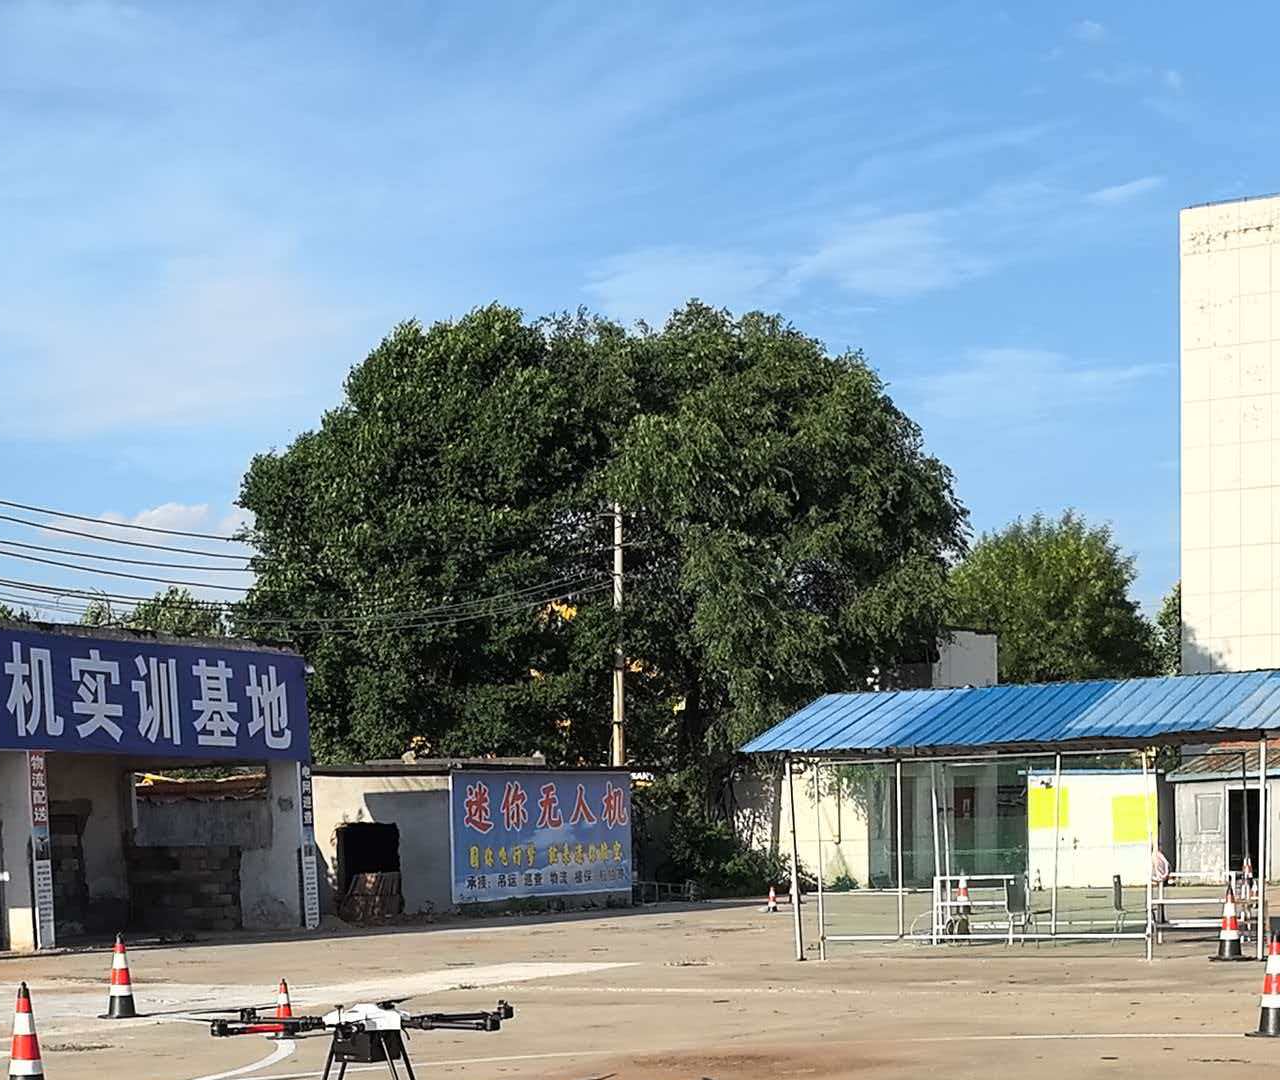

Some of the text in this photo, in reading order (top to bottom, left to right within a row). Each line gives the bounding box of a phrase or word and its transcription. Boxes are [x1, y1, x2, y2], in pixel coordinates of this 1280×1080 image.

[30, 755, 48, 822] 物流配送
[464, 781, 628, 834] 迷你无人机
